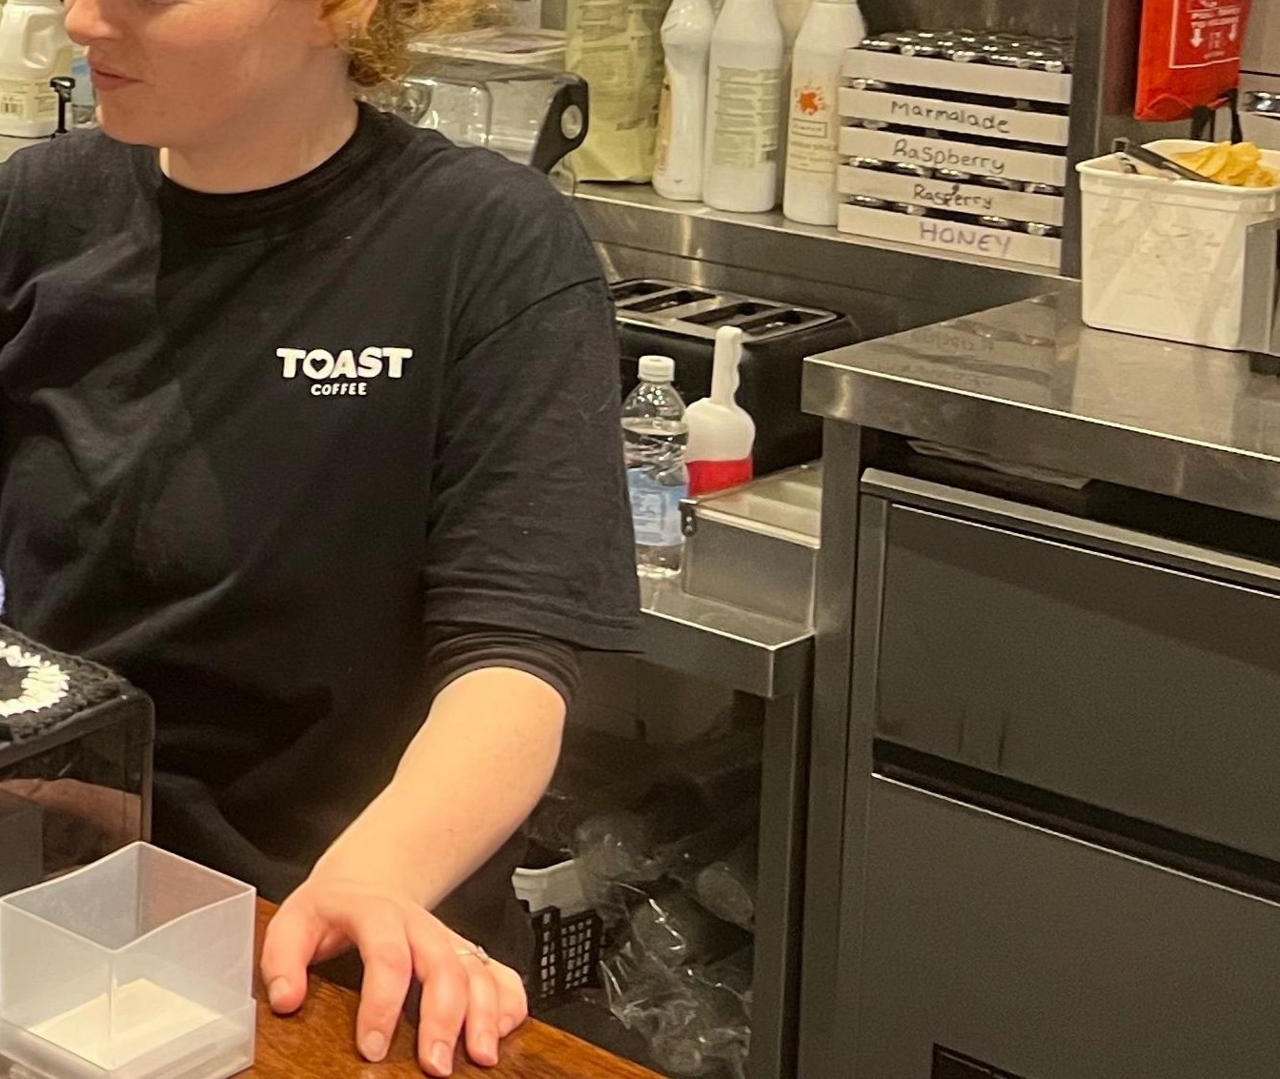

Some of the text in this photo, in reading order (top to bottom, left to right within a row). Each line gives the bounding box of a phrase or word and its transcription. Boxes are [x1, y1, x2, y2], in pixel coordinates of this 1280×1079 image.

[891, 100, 1010, 134] Marmalade
[893, 138, 1006, 177] Raspberry
[919, 221, 1012, 255] HONEY
[276, 346, 413, 379] TOAST
[310, 382, 368, 396] COFFEE
